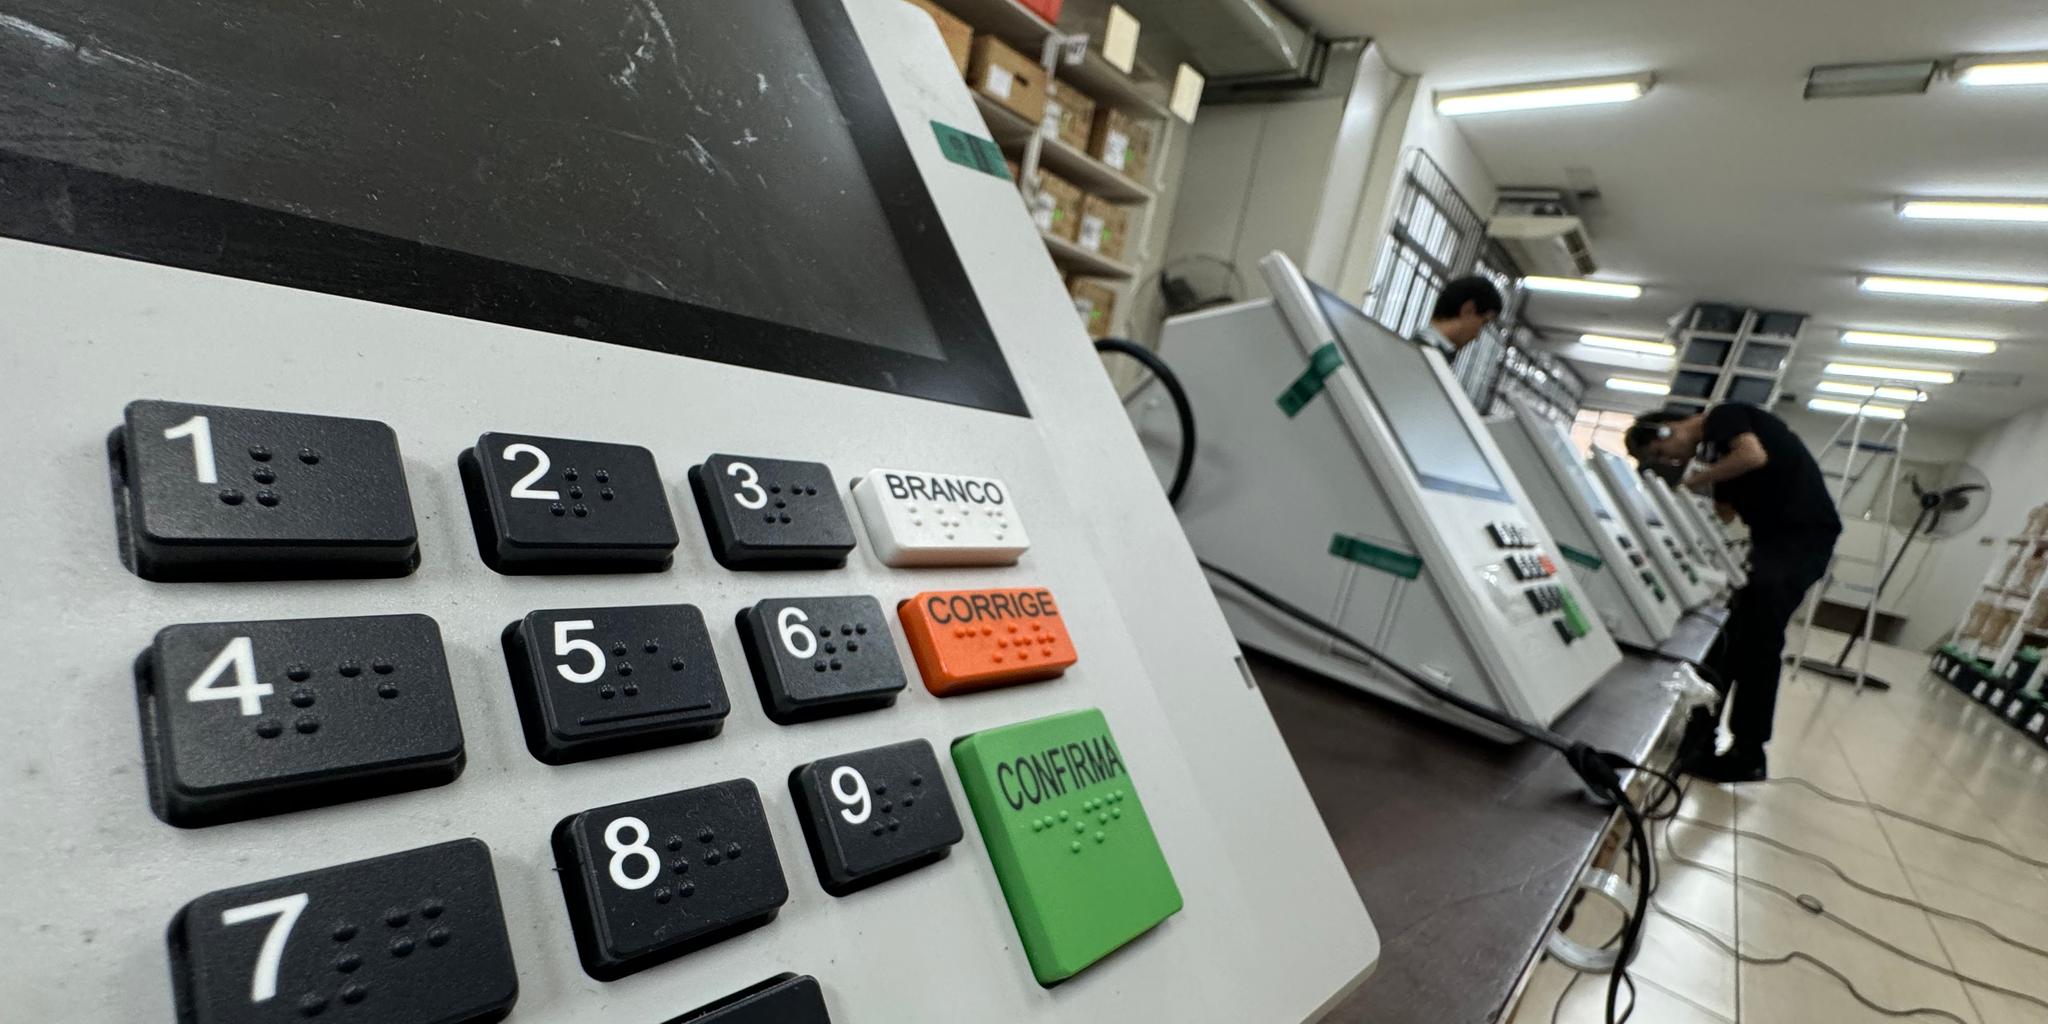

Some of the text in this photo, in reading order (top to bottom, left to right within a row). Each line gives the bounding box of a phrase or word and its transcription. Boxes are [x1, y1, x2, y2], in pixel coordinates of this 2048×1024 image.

[163, 415, 218, 484] 1
[502, 443, 560, 500] 2
[727, 461, 768, 510] 3
[885, 473, 1004, 505] BRANCO
[777, 606, 818, 659] 6
[927, 591, 1058, 625] CORRIGE
[186, 636, 274, 716] 4
[554, 619, 606, 684] 5
[830, 765, 872, 825] 9
[997, 734, 1127, 811] CONFIRMA
[604, 816, 661, 890] 8
[222, 892, 309, 1002] 7
